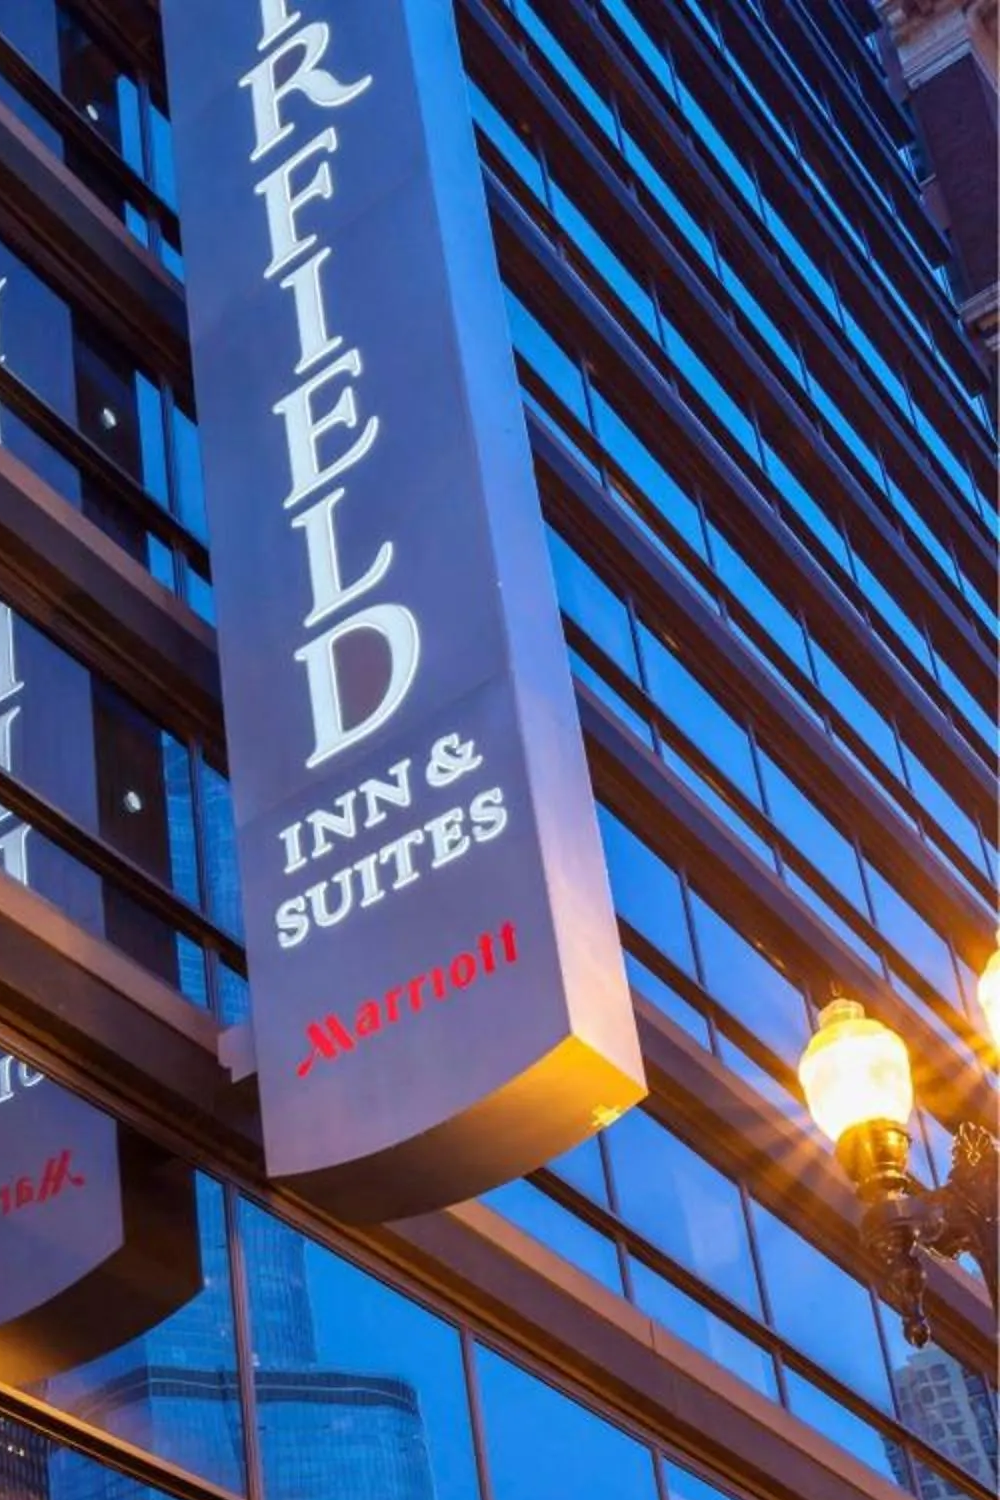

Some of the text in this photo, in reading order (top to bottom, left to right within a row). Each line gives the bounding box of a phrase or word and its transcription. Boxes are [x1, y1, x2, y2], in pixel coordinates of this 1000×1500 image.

[275, 786, 509, 950] SUITES
[279, 732, 484, 876] INN &
[297, 921, 518, 1078] Marriott
